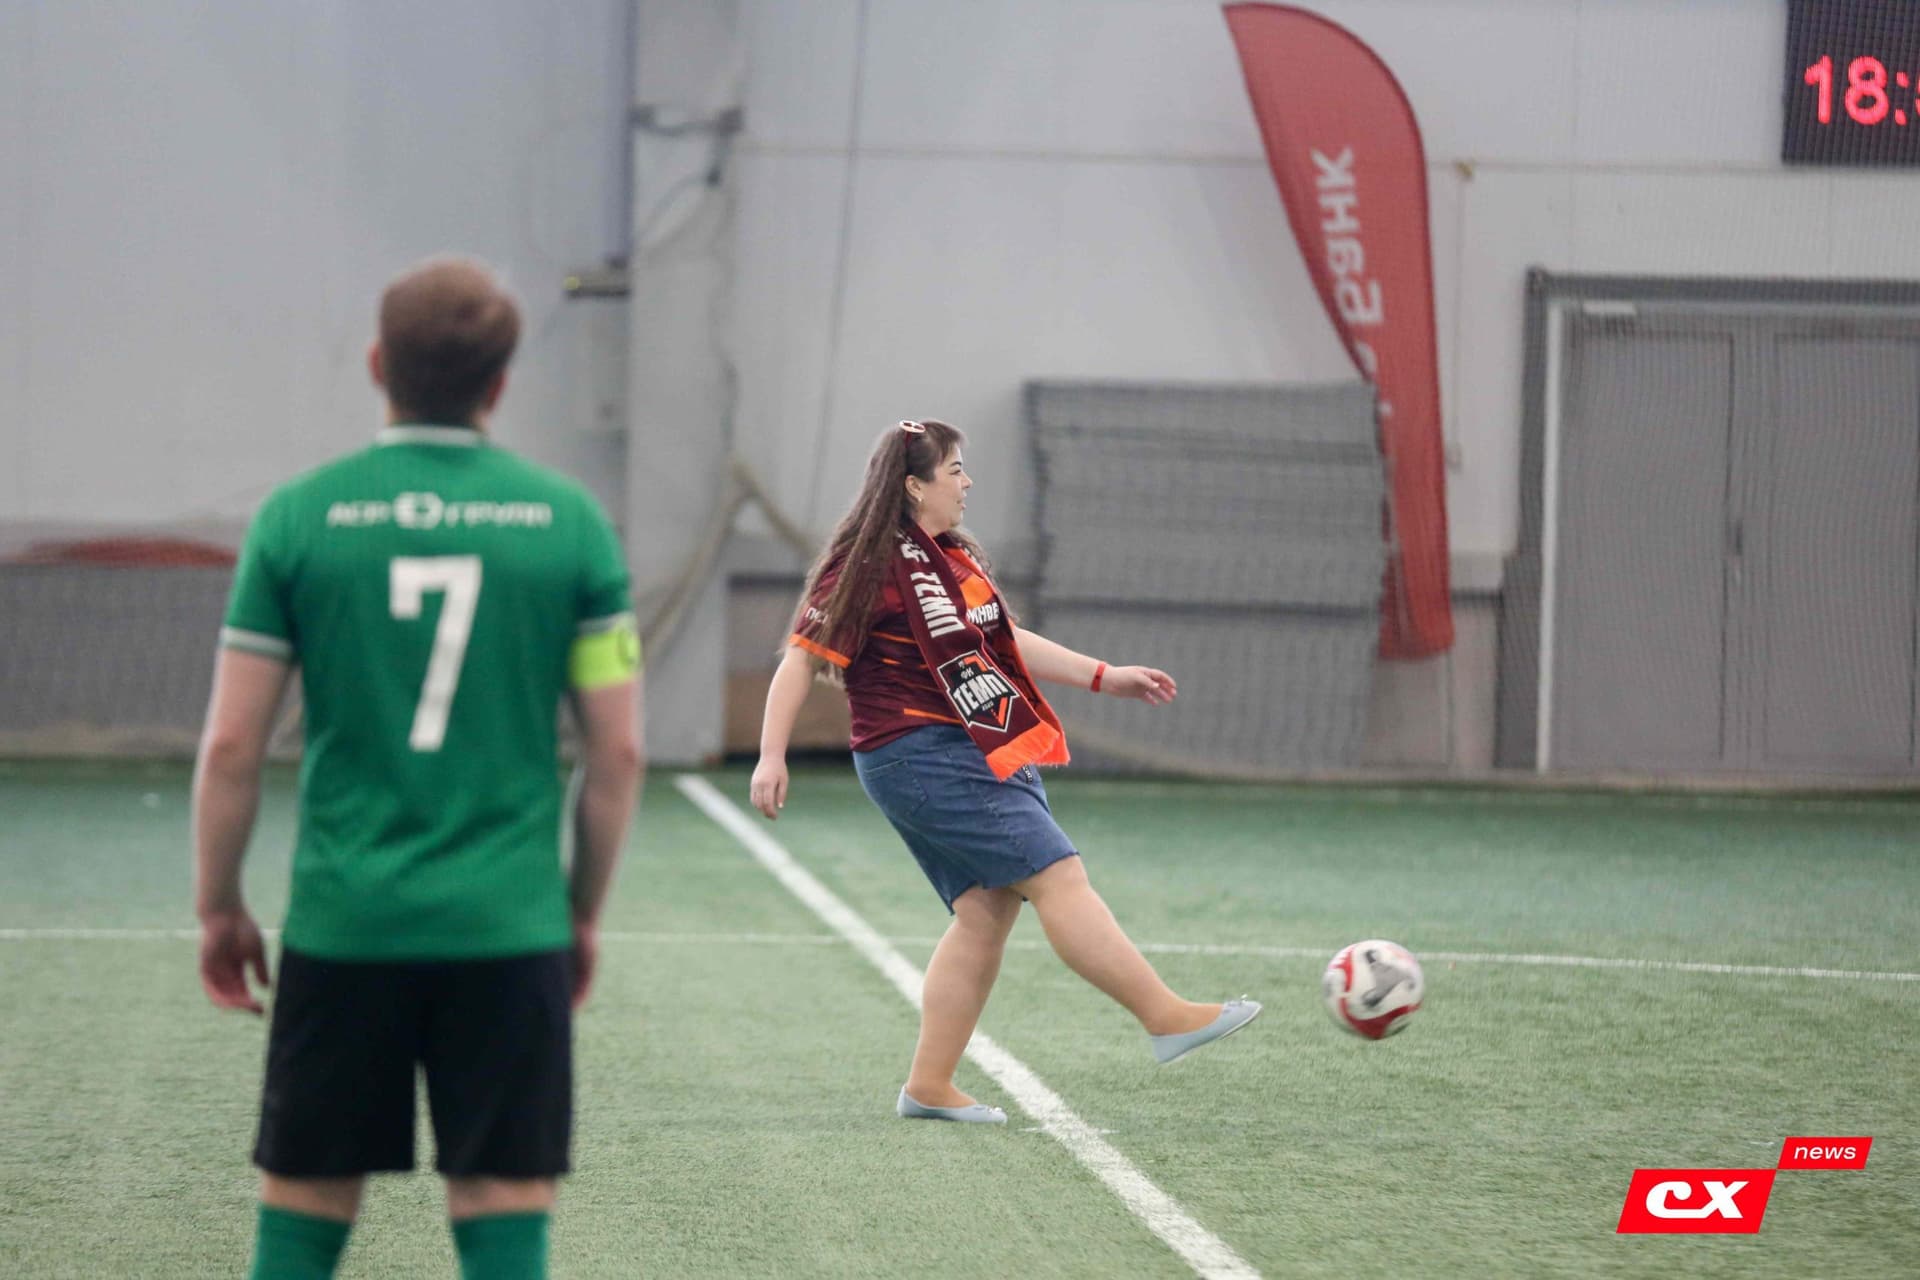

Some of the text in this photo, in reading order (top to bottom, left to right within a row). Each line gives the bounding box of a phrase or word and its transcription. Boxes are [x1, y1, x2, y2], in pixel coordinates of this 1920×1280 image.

[910, 572, 966, 639] ТЕМП
[389, 555, 482, 752] 7
[952, 673, 1009, 716] ТЕМП
